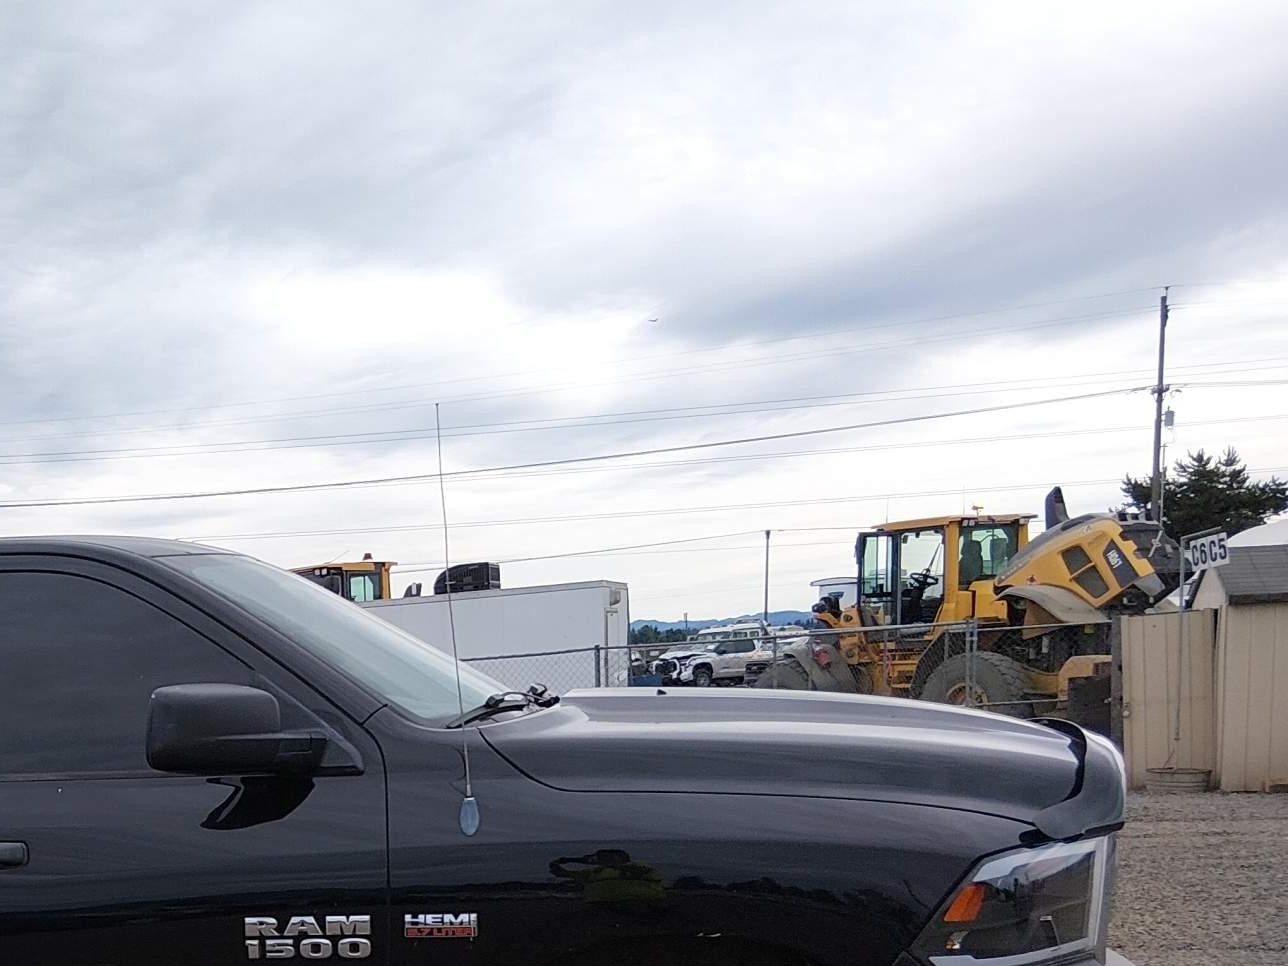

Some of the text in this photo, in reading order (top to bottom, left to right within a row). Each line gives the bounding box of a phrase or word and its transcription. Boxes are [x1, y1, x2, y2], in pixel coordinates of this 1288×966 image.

[1191, 537, 1227, 567] C6 C5
[244, 914, 371, 937] RAM
[404, 913, 478, 926] HEMI
[245, 937, 371, 960] 1500
